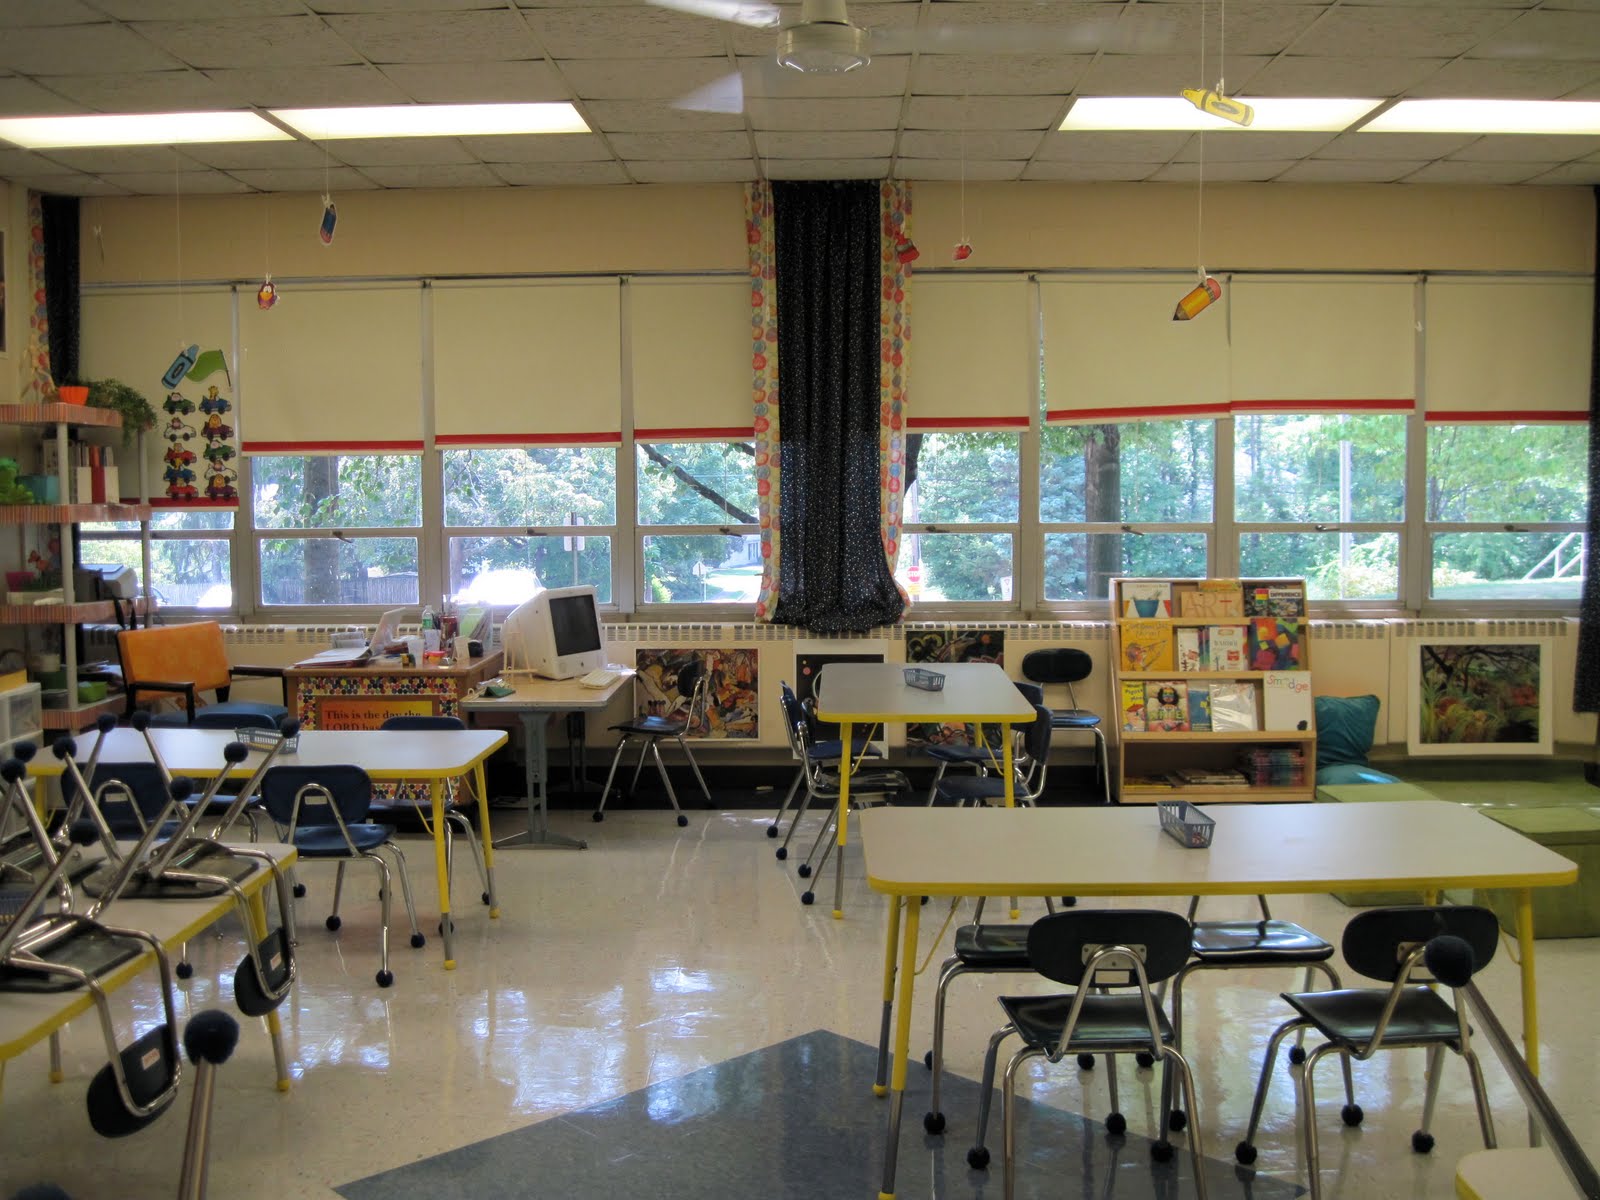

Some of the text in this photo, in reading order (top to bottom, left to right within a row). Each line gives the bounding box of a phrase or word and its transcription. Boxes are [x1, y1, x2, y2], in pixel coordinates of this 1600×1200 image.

[327, 710, 349, 719] This
[352, 710, 361, 719] is
[364, 710, 380, 719] the
